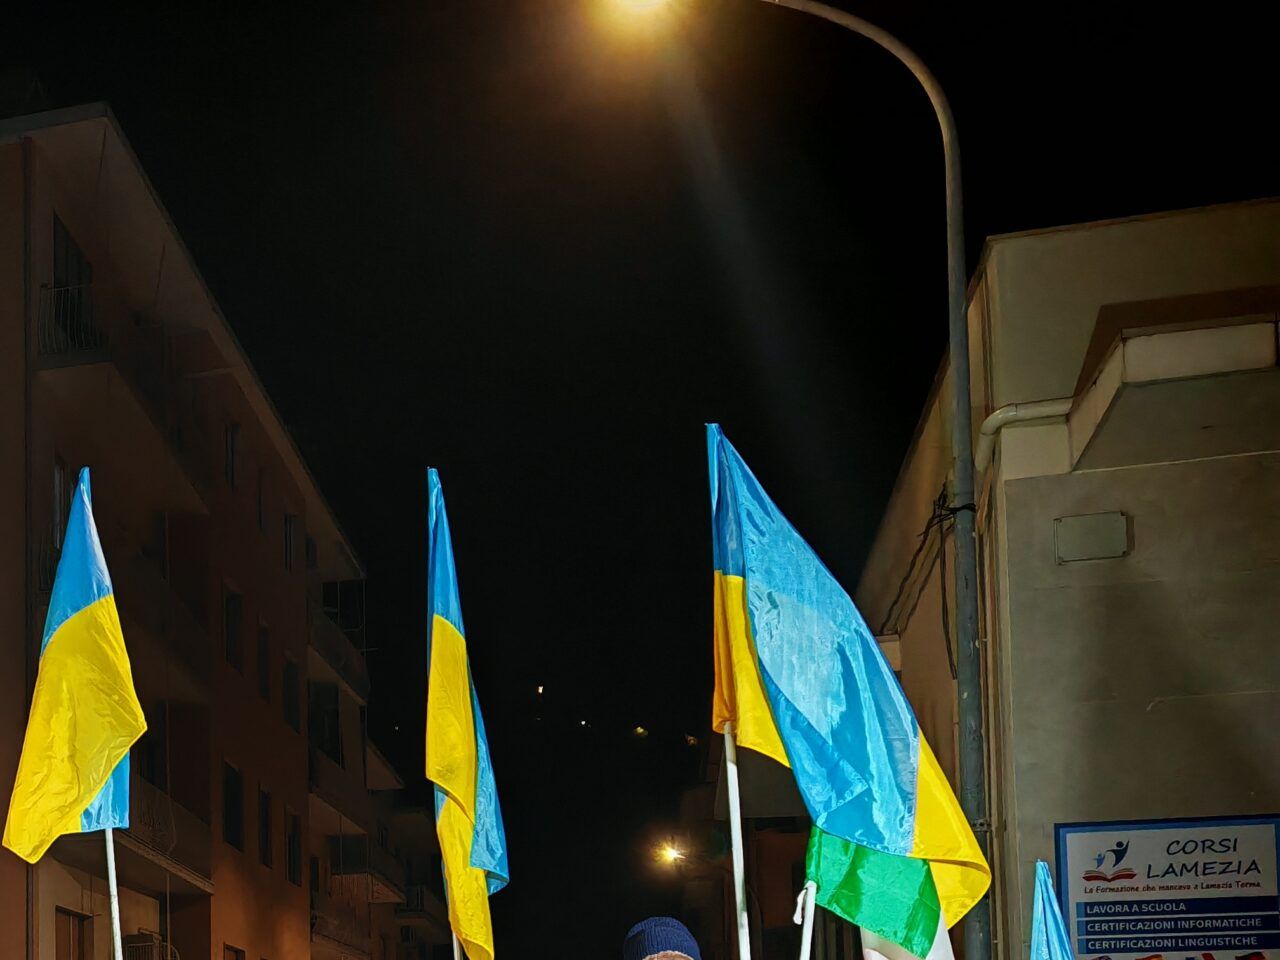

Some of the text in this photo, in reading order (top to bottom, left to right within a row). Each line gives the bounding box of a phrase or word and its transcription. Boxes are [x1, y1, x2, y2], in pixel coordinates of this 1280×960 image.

[1166, 838, 1238, 855] CORSI
[1147, 859, 1262, 879] LAMEZIA
[1096, 884, 1139, 893] Formazione
[1200, 881, 1233, 890] Lamezia
[1087, 902, 1187, 914] LAVORA A SCUOLA
[1087, 918, 1262, 932] CERTIFICAZIONI INFORMATICHE
[1088, 937, 1258, 950] CERTIFICAZIONI LINGUISTICHE
